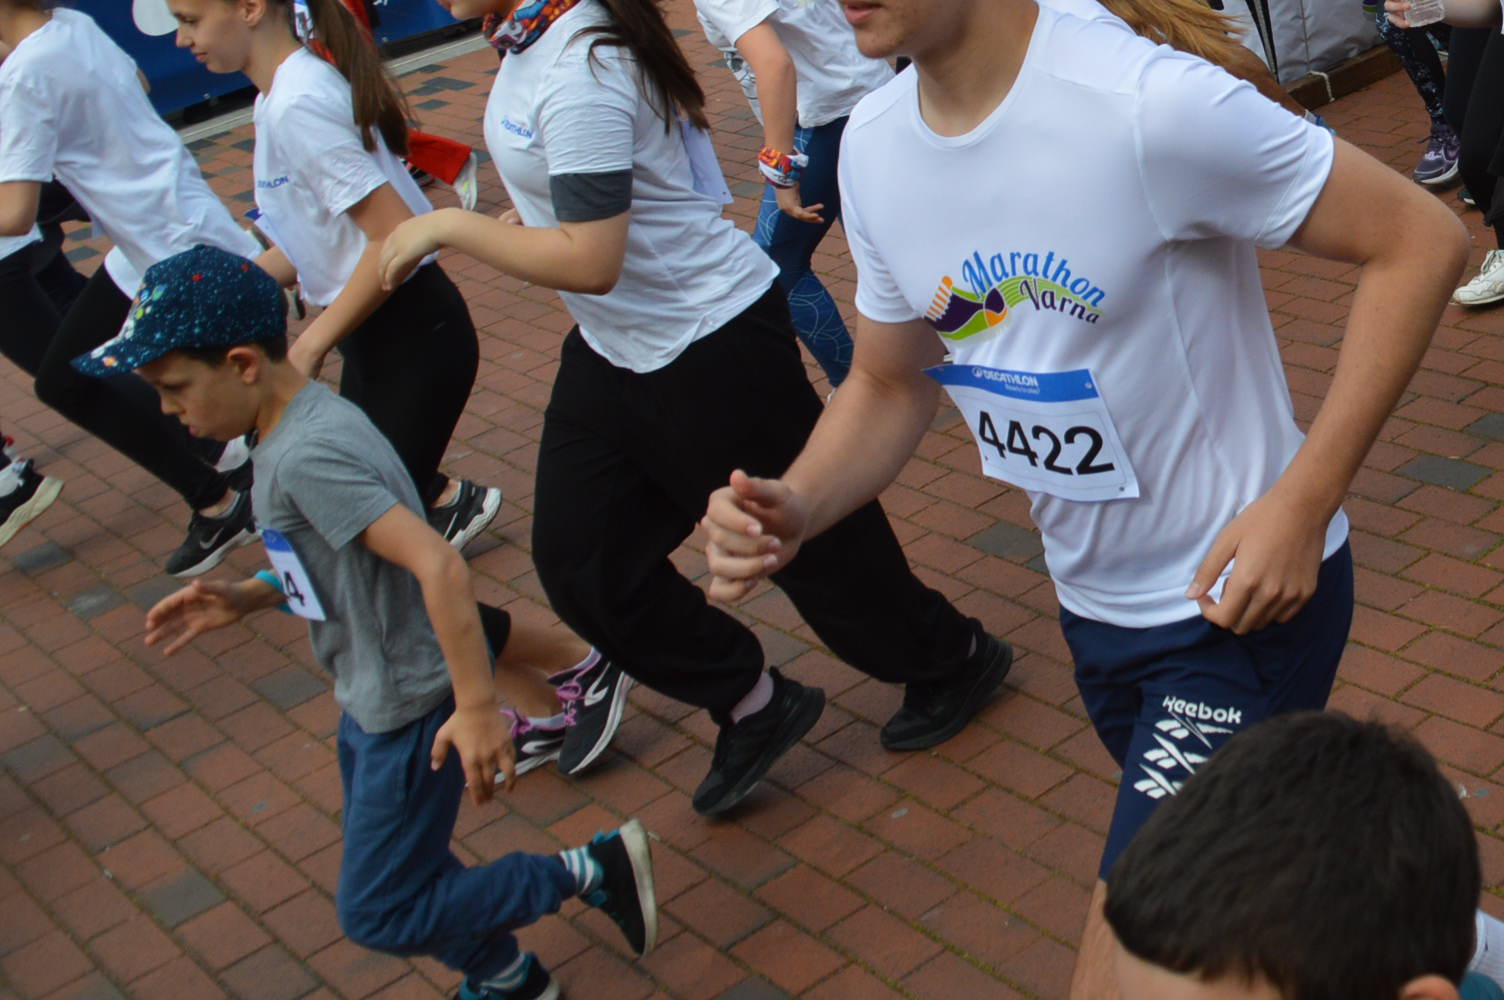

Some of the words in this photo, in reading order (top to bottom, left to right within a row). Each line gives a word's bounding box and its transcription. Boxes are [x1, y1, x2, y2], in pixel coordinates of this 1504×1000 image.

[962, 250, 1105, 308] Marathon
[1019, 278, 1100, 324] Varna
[982, 369, 1039, 387] DECATHLON
[978, 410, 1115, 476] 4422
